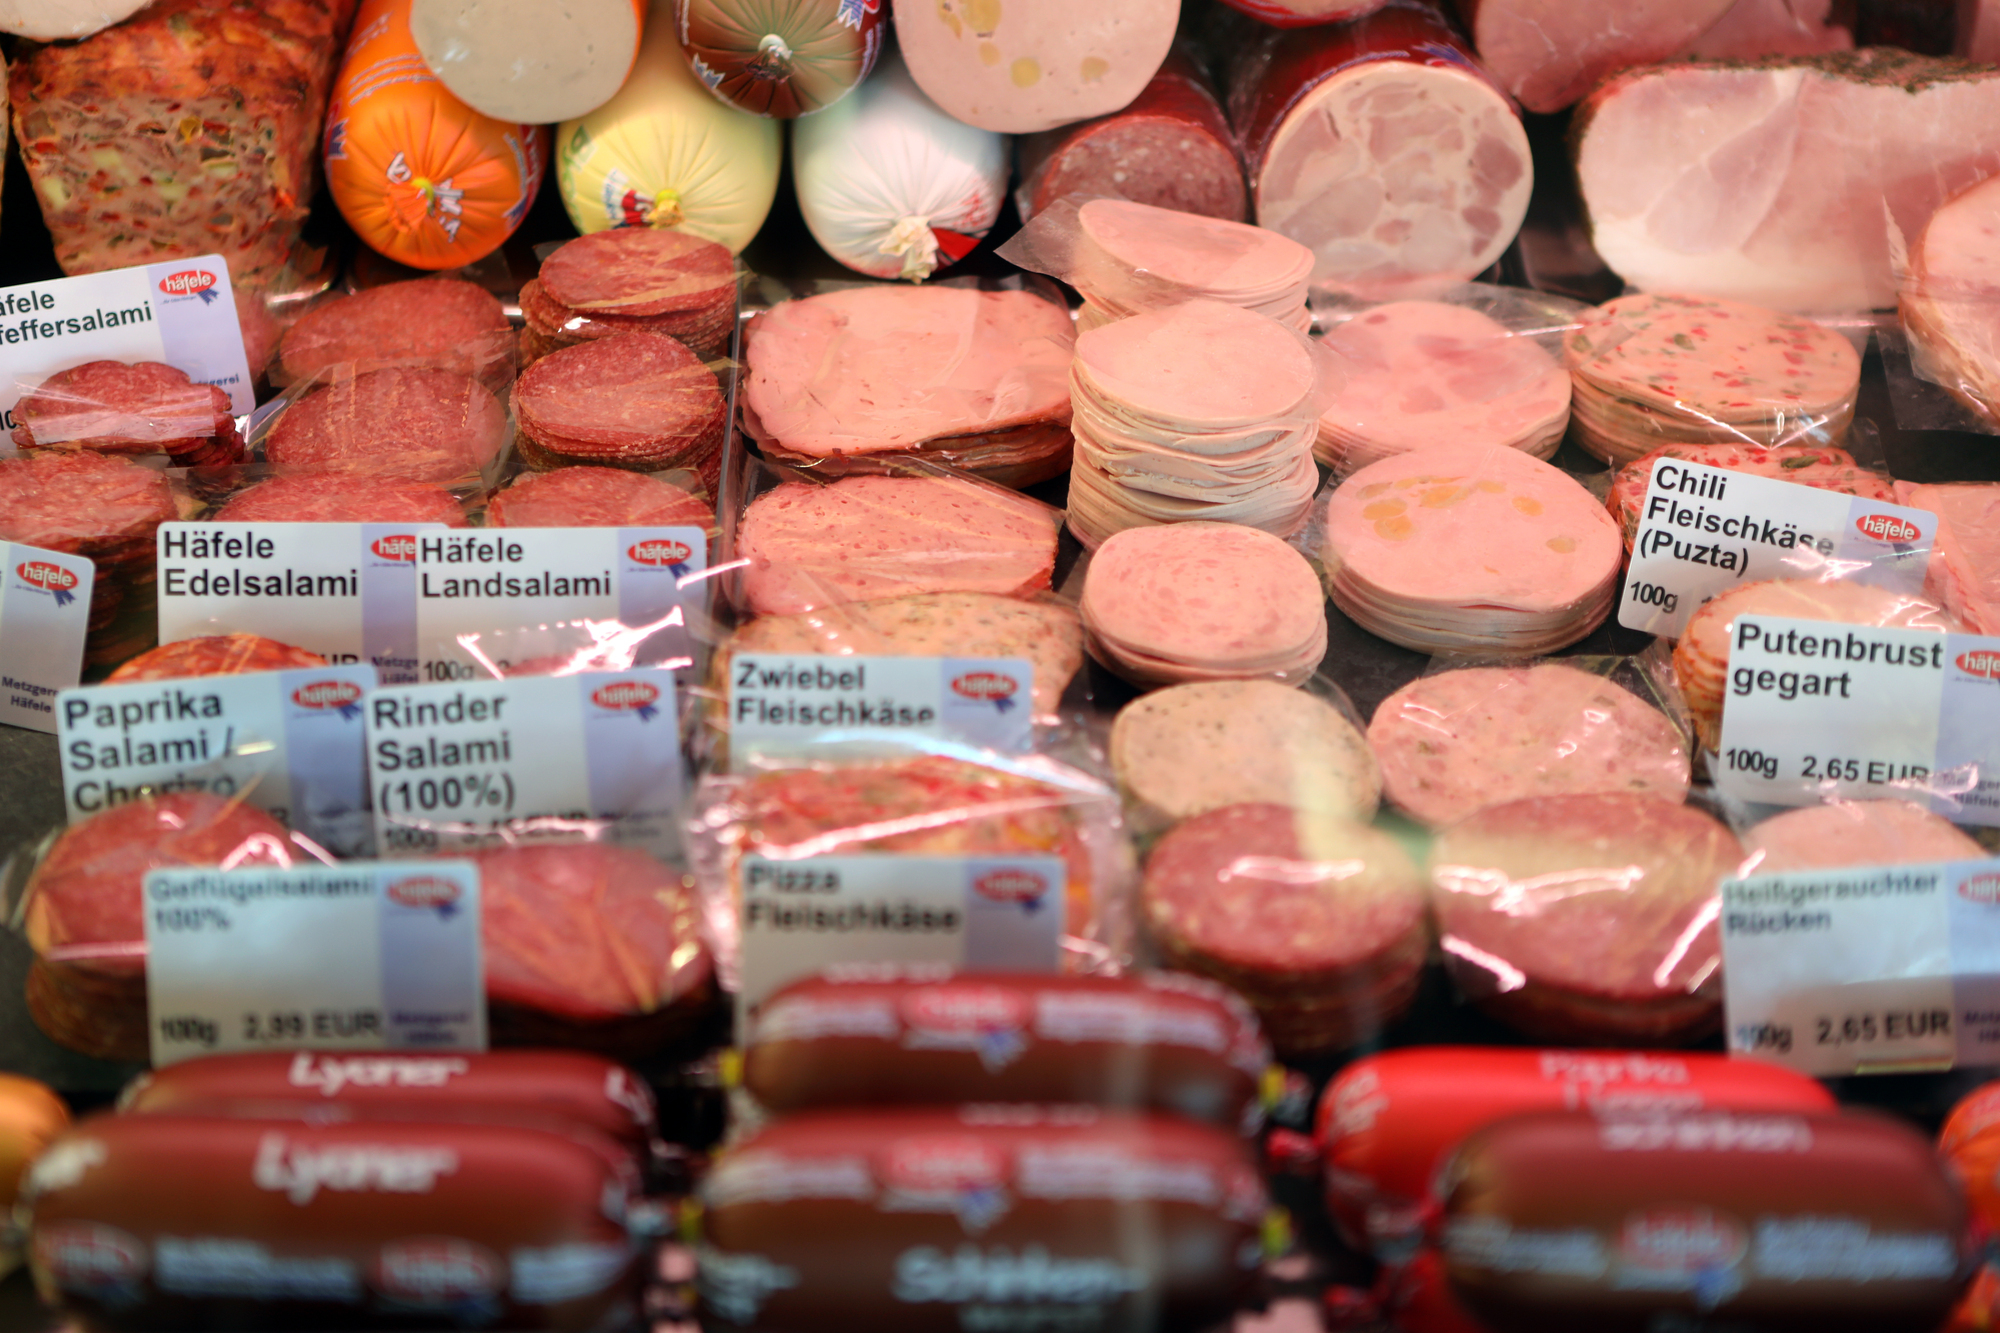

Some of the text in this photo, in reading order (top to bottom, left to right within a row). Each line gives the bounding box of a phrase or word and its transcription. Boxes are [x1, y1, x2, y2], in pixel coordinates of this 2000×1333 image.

[165, 269, 212, 295] häfele
[0, 290, 55, 317] fele
[0, 301, 153, 346] effersalami
[1655, 464, 1728, 501] Chili
[1647, 495, 1836, 557] Fleischkäse
[1863, 514, 1916, 541] häfele
[164, 531, 274, 559] Häfele
[378, 539, 416, 560] häfe
[422, 537, 524, 562] Häfele
[634, 540, 689, 566] häfele
[1641, 528, 1749, 579] (Puzta)
[24, 561, 74, 589] häfele
[164, 568, 358, 597] Edelsalami
[422, 570, 612, 598] Landsalami
[1630, 581, 1679, 614] 100g
[1737, 623, 1944, 669] Putenbrust
[371, 656, 418, 670] Metzge
[737, 662, 866, 690] Zwiebel
[1965, 651, 2000, 679] häfe
[2, 676, 59, 697] Metzger
[382, 673, 418, 684] Häfel
[1733, 667, 1851, 700] gegart
[11, 695, 52, 713] Häfele
[64, 690, 223, 733] Paprika
[374, 692, 508, 730] Rinder
[737, 697, 935, 726] Fleischkäse
[69, 729, 209, 771] Salami
[376, 731, 512, 772] Salami
[1726, 748, 1930, 785] 100g 2,65 EUR
[73, 772, 237, 813] Choo
[380, 772, 515, 816] (100%)
[747, 863, 840, 892] Pizza
[155, 905, 232, 933] 100%
[747, 901, 960, 932] Fleischkäse
[1727, 910, 1832, 936] Rücken
[242, 1010, 307, 1042] 2,99
[311, 1007, 381, 1039] EUR
[1816, 1014, 1877, 1047] 2,65
[1885, 1010, 1952, 1039] EUR
